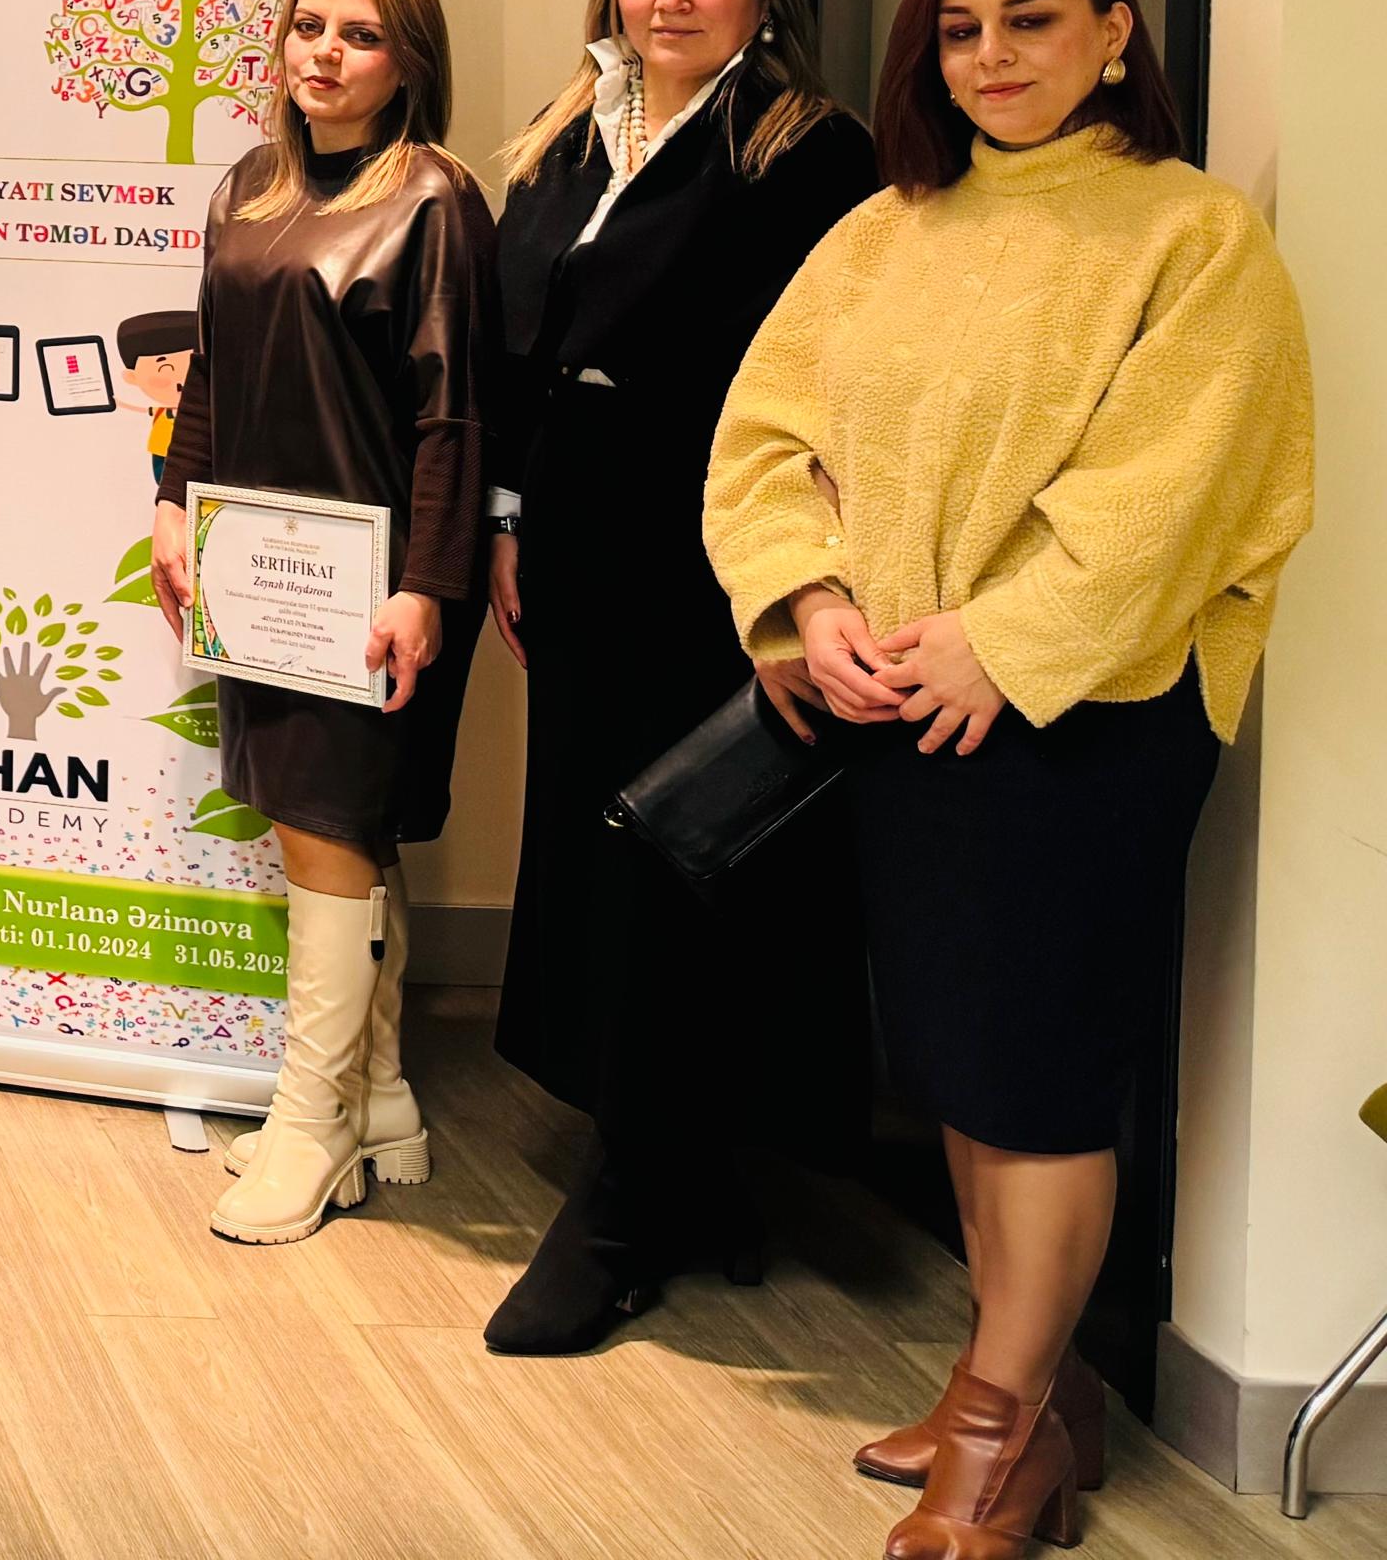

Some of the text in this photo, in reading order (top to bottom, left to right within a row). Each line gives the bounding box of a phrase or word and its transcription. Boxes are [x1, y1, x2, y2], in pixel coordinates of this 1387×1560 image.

[60, 182, 175, 206] SEVMƏK
[16, 223, 106, 246] TƏMƏL
[114, 226, 206, 253] DAŞID
[251, 554, 336, 580] SERTİFİKAT
[3, 888, 119, 925] Nurlanə
[128, 905, 253, 941] Əzimova
[31, 927, 152, 960] 01.10.2024
[174, 944, 288, 975] 31.05.202
